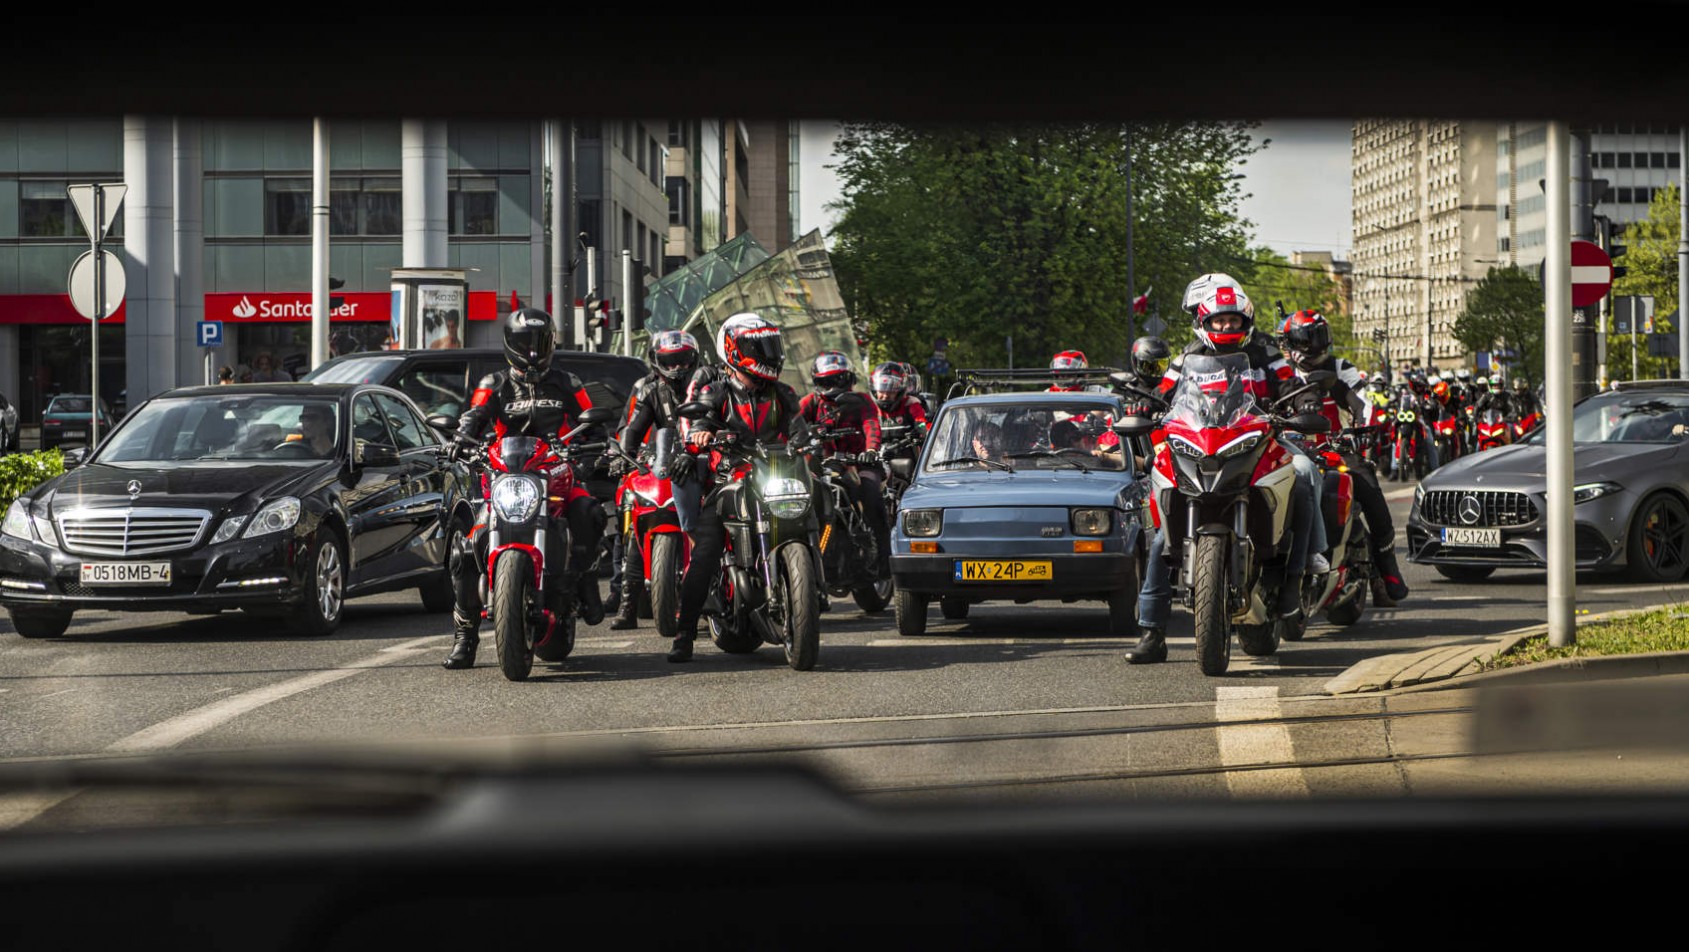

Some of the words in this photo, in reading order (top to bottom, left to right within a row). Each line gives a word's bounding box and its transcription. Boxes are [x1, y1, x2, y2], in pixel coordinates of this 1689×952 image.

[260, 299, 358, 317] Santaer
[202, 324, 217, 343] P
[93, 565, 167, 581] 0518MB-4
[966, 562, 987, 579] WX
[993, 562, 1024, 579] 24P
